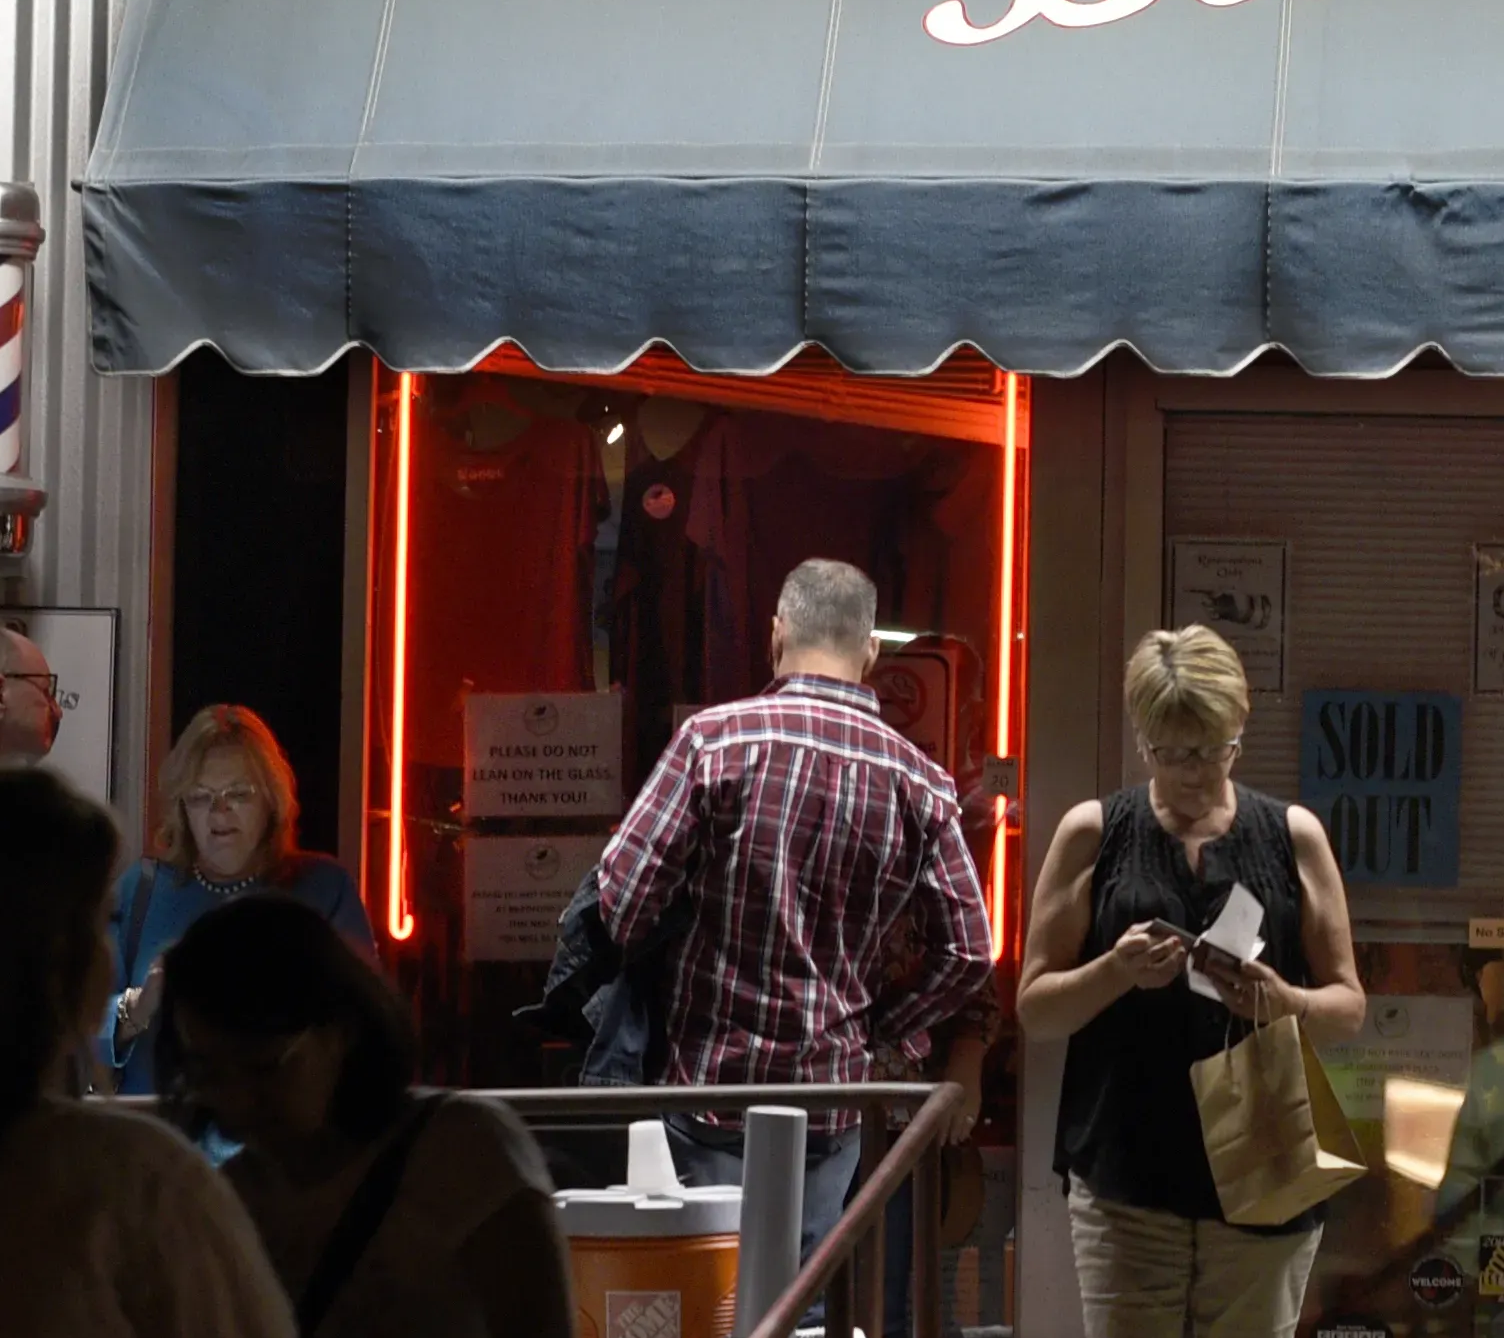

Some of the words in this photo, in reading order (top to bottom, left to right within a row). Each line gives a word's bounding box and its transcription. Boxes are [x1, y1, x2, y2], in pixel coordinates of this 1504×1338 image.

[1318, 701, 1444, 781] SOLD
[489, 745, 536, 758] PLEASE
[543, 745, 564, 757] DO
[568, 744, 599, 757] NOT
[473, 768, 508, 781] LEAN
[512, 768, 533, 781] ON
[538, 768, 564, 781] THE
[501, 791, 548, 804] THANK
[1329, 794, 1431, 874] OUT
[1476, 927, 1493, 938] No
[1411, 1277, 1462, 1288] WELCOME
